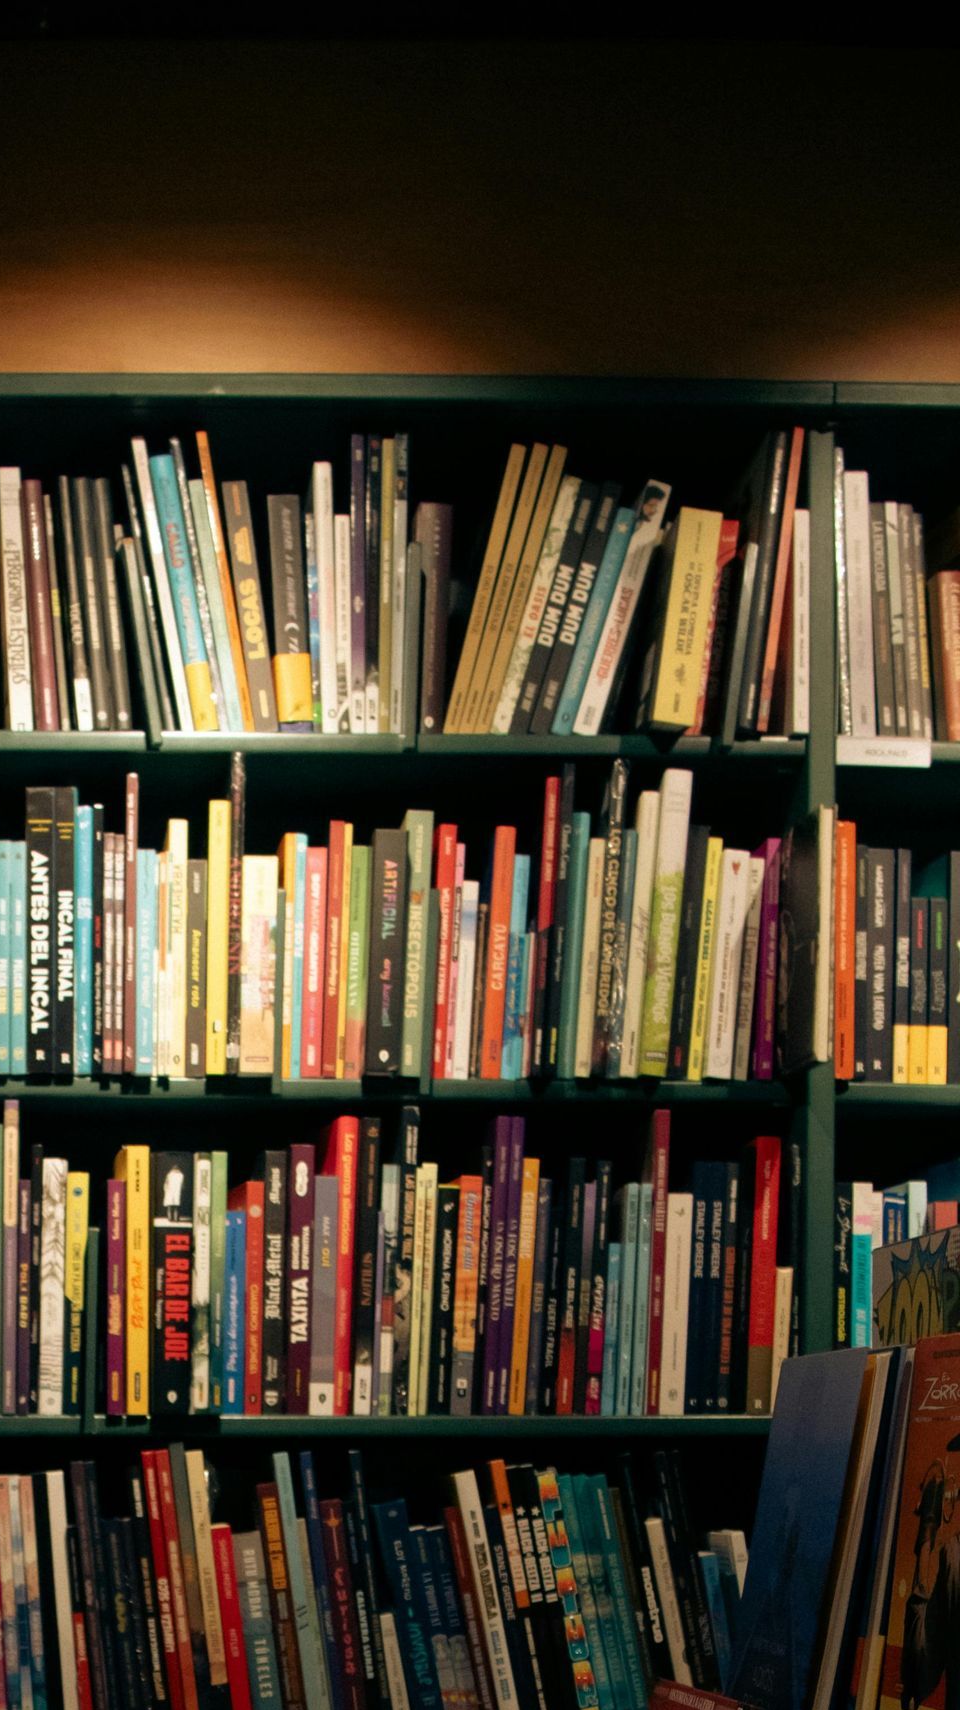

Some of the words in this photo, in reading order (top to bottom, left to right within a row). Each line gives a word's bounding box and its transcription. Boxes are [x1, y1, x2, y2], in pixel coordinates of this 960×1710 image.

[240, 579, 266, 660] LOCAS
[537, 606, 560, 647] DUM
[550, 564, 574, 605] DUM
[559, 606, 583, 646] DUM
[575, 562, 597, 604] DUM
[30, 851, 50, 923] ANTES
[381, 860, 398, 939] ARTIFICIAL
[58, 890, 74, 946] INCAL
[31, 925, 50, 965] DEL
[191, 929, 201, 985] Amanecer
[404, 904, 424, 1018] INSECTÓPOLIS
[490, 924, 508, 990] CARCAYÚ
[58, 949, 74, 1001] FINAL
[31, 968, 50, 1034] INCAL
[192, 988, 201, 1008] roto
[344, 1134, 352, 1153] Las
[342, 1155, 351, 1195] guerras
[694, 1200, 705, 1241] STANLEY
[711, 1200, 722, 1241] STANLEY
[165, 1235, 188, 1253] EL
[266, 1234, 282, 1277] Metal
[441, 1229, 451, 1270] MORENA
[694, 1243, 705, 1279] GREENE
[710, 1243, 721, 1279] GREENE
[165, 1258, 188, 1297] BAR
[440, 1272, 450, 1312] PLATINO
[165, 1300, 189, 1323] DE
[265, 1278, 281, 1321] Black
[290, 1277, 308, 1344] TAXISTA
[164, 1326, 189, 1361] JOE
[243, 1549, 257, 1578] RUTU
[495, 1545, 509, 1584] STANLEY
[246, 1580, 263, 1619] MODAN
[355, 1591, 371, 1643] CALAVERA
[500, 1585, 515, 1621] GREENE
[253, 1639, 273, 1699] TÚNELES
[361, 1645, 375, 1679] LUNAR
